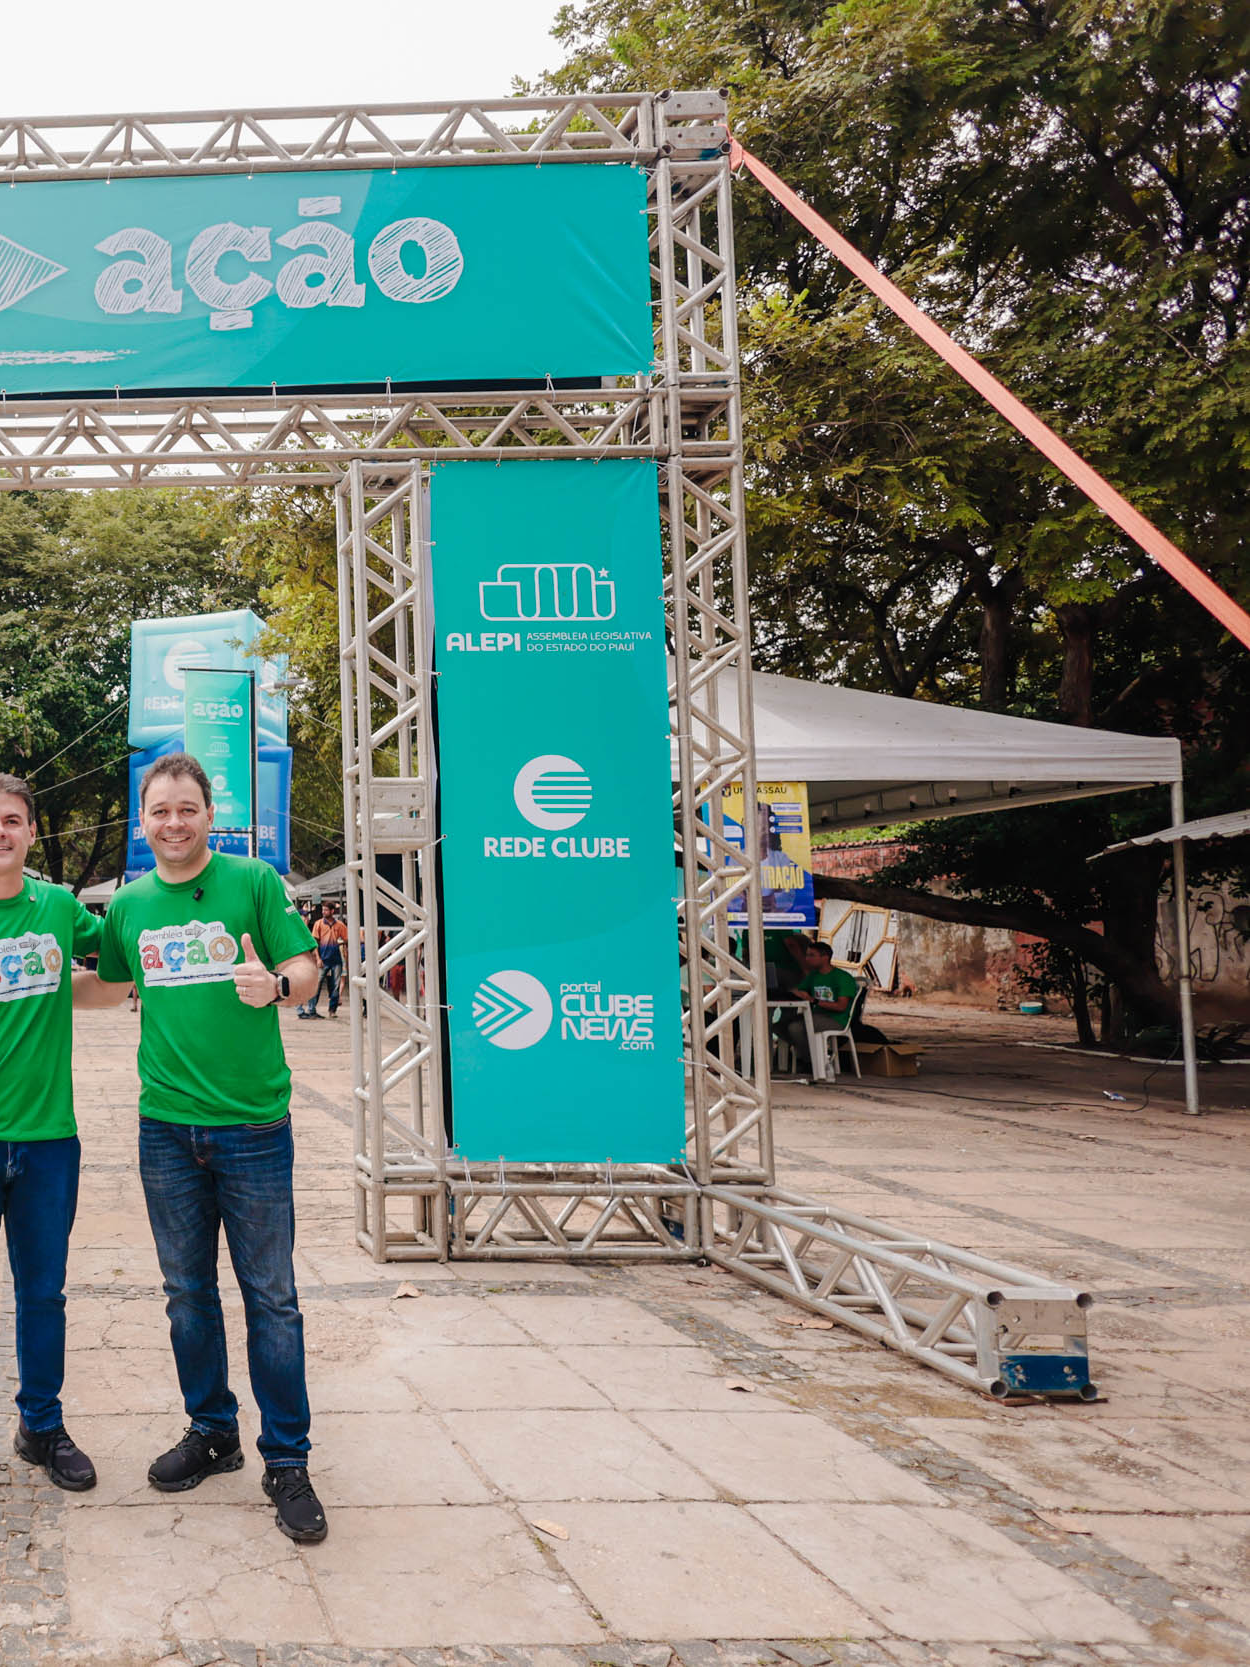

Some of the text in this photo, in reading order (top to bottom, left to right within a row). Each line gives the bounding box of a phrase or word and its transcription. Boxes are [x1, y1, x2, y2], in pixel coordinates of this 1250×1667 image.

[93, 195, 465, 331] ação
[445, 631, 652, 652] ALEPI ASSEMBLEIA LEGISLATIVA
[526, 641, 635, 652] DO ESTADO DO PIAUÍ
[483, 836, 631, 858] REDE CLUBE
[560, 981, 601, 994] portal
[560, 994, 654, 1017] CLUBE
[561, 1018, 654, 1041] NEWS
[618, 1040, 655, 1050] .com
